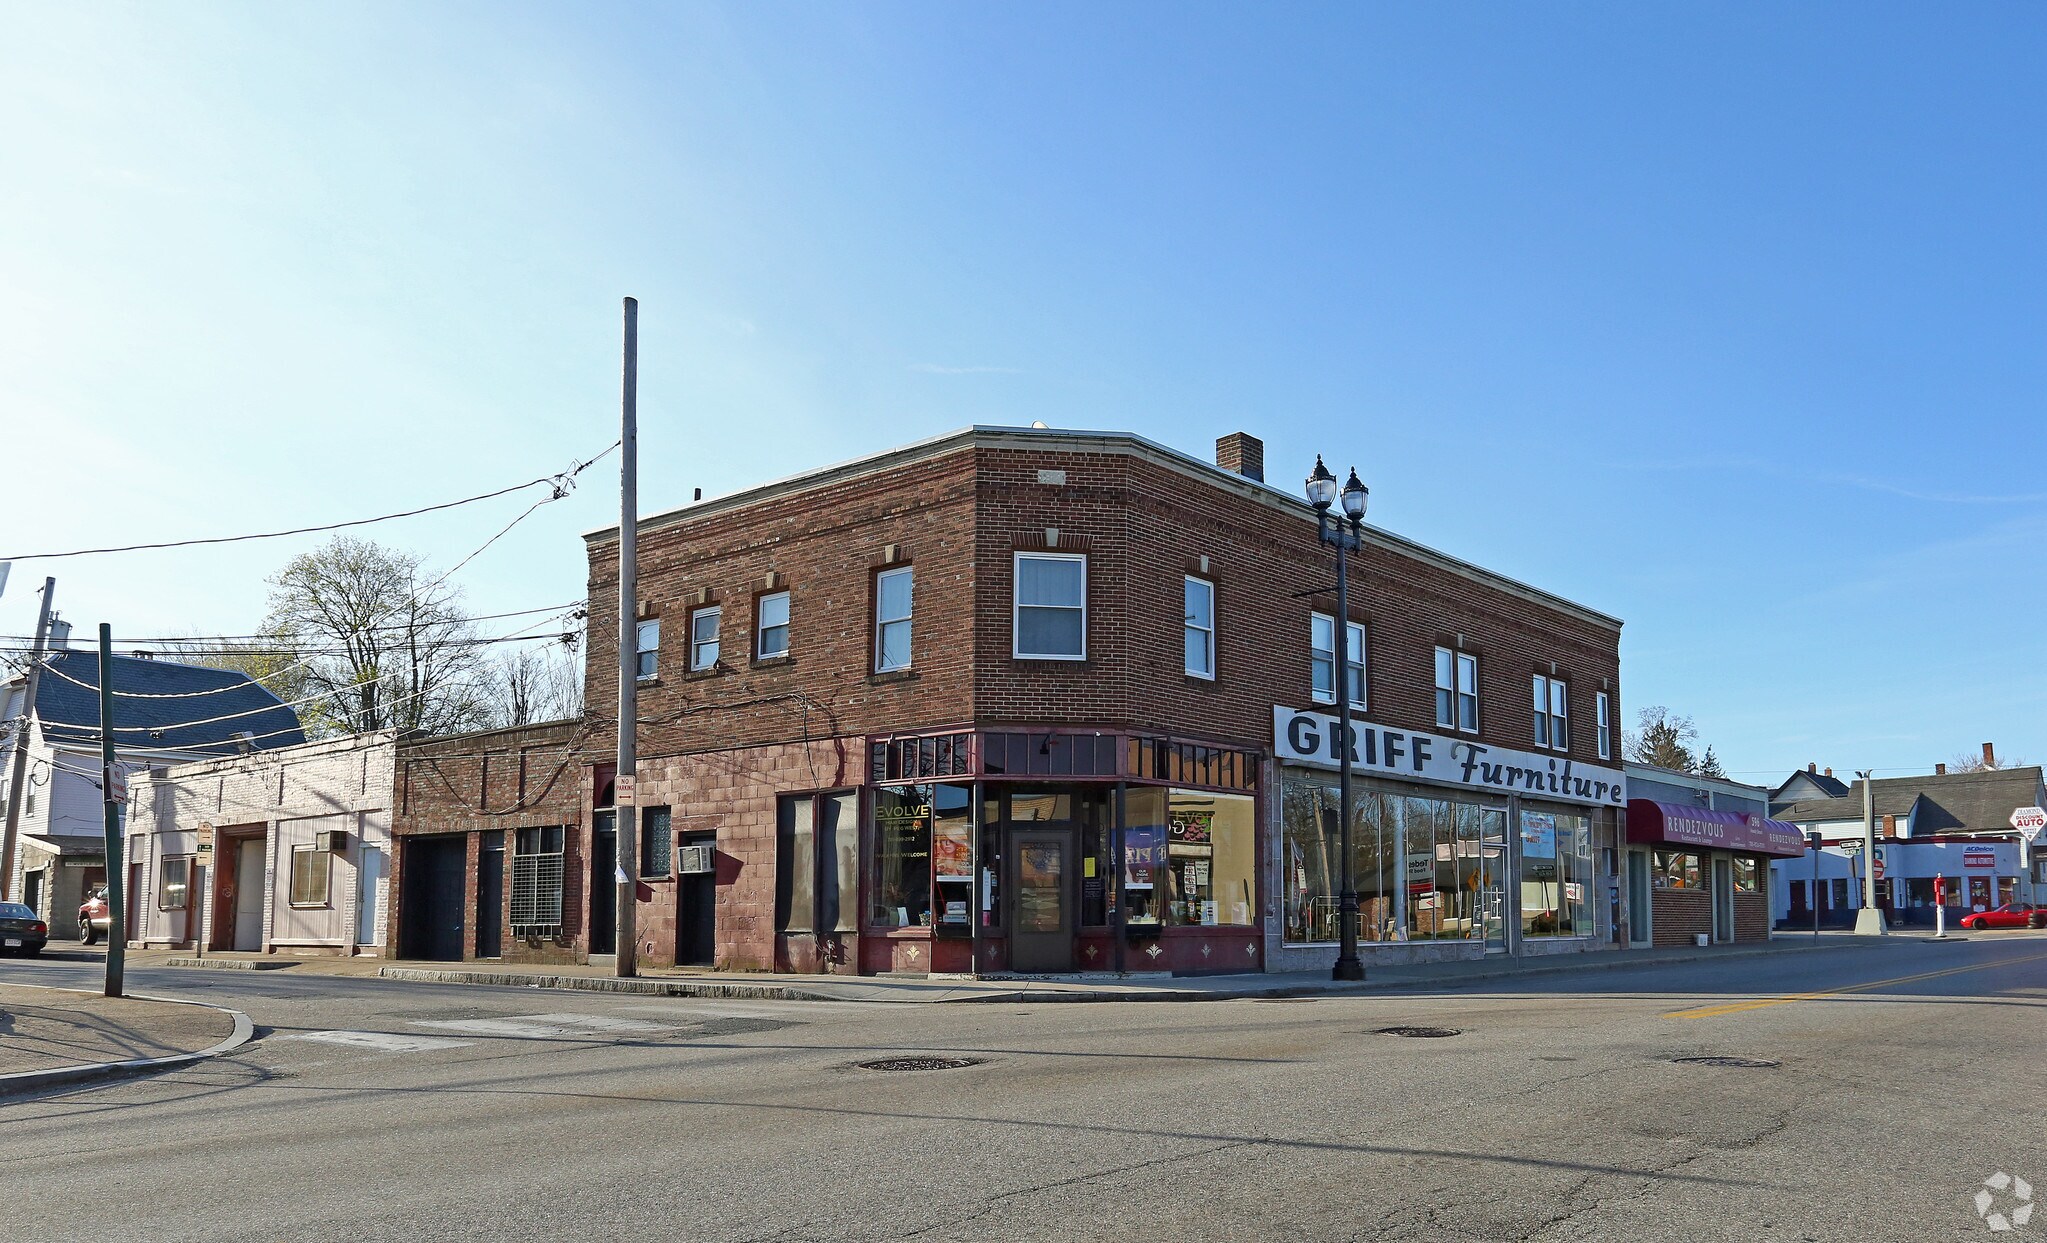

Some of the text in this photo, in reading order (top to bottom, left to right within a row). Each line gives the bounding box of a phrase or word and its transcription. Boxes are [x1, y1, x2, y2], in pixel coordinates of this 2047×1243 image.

[1287, 715, 1622, 803] GRIFF Furniture
[876, 804, 929, 818] EVOLVE
[1668, 816, 1724, 838] RENDEZVOUS
[1751, 816, 1760, 828] 596
[2016, 819, 2044, 827] AUTO
[1769, 833, 1801, 846] RENDEZVOUS
